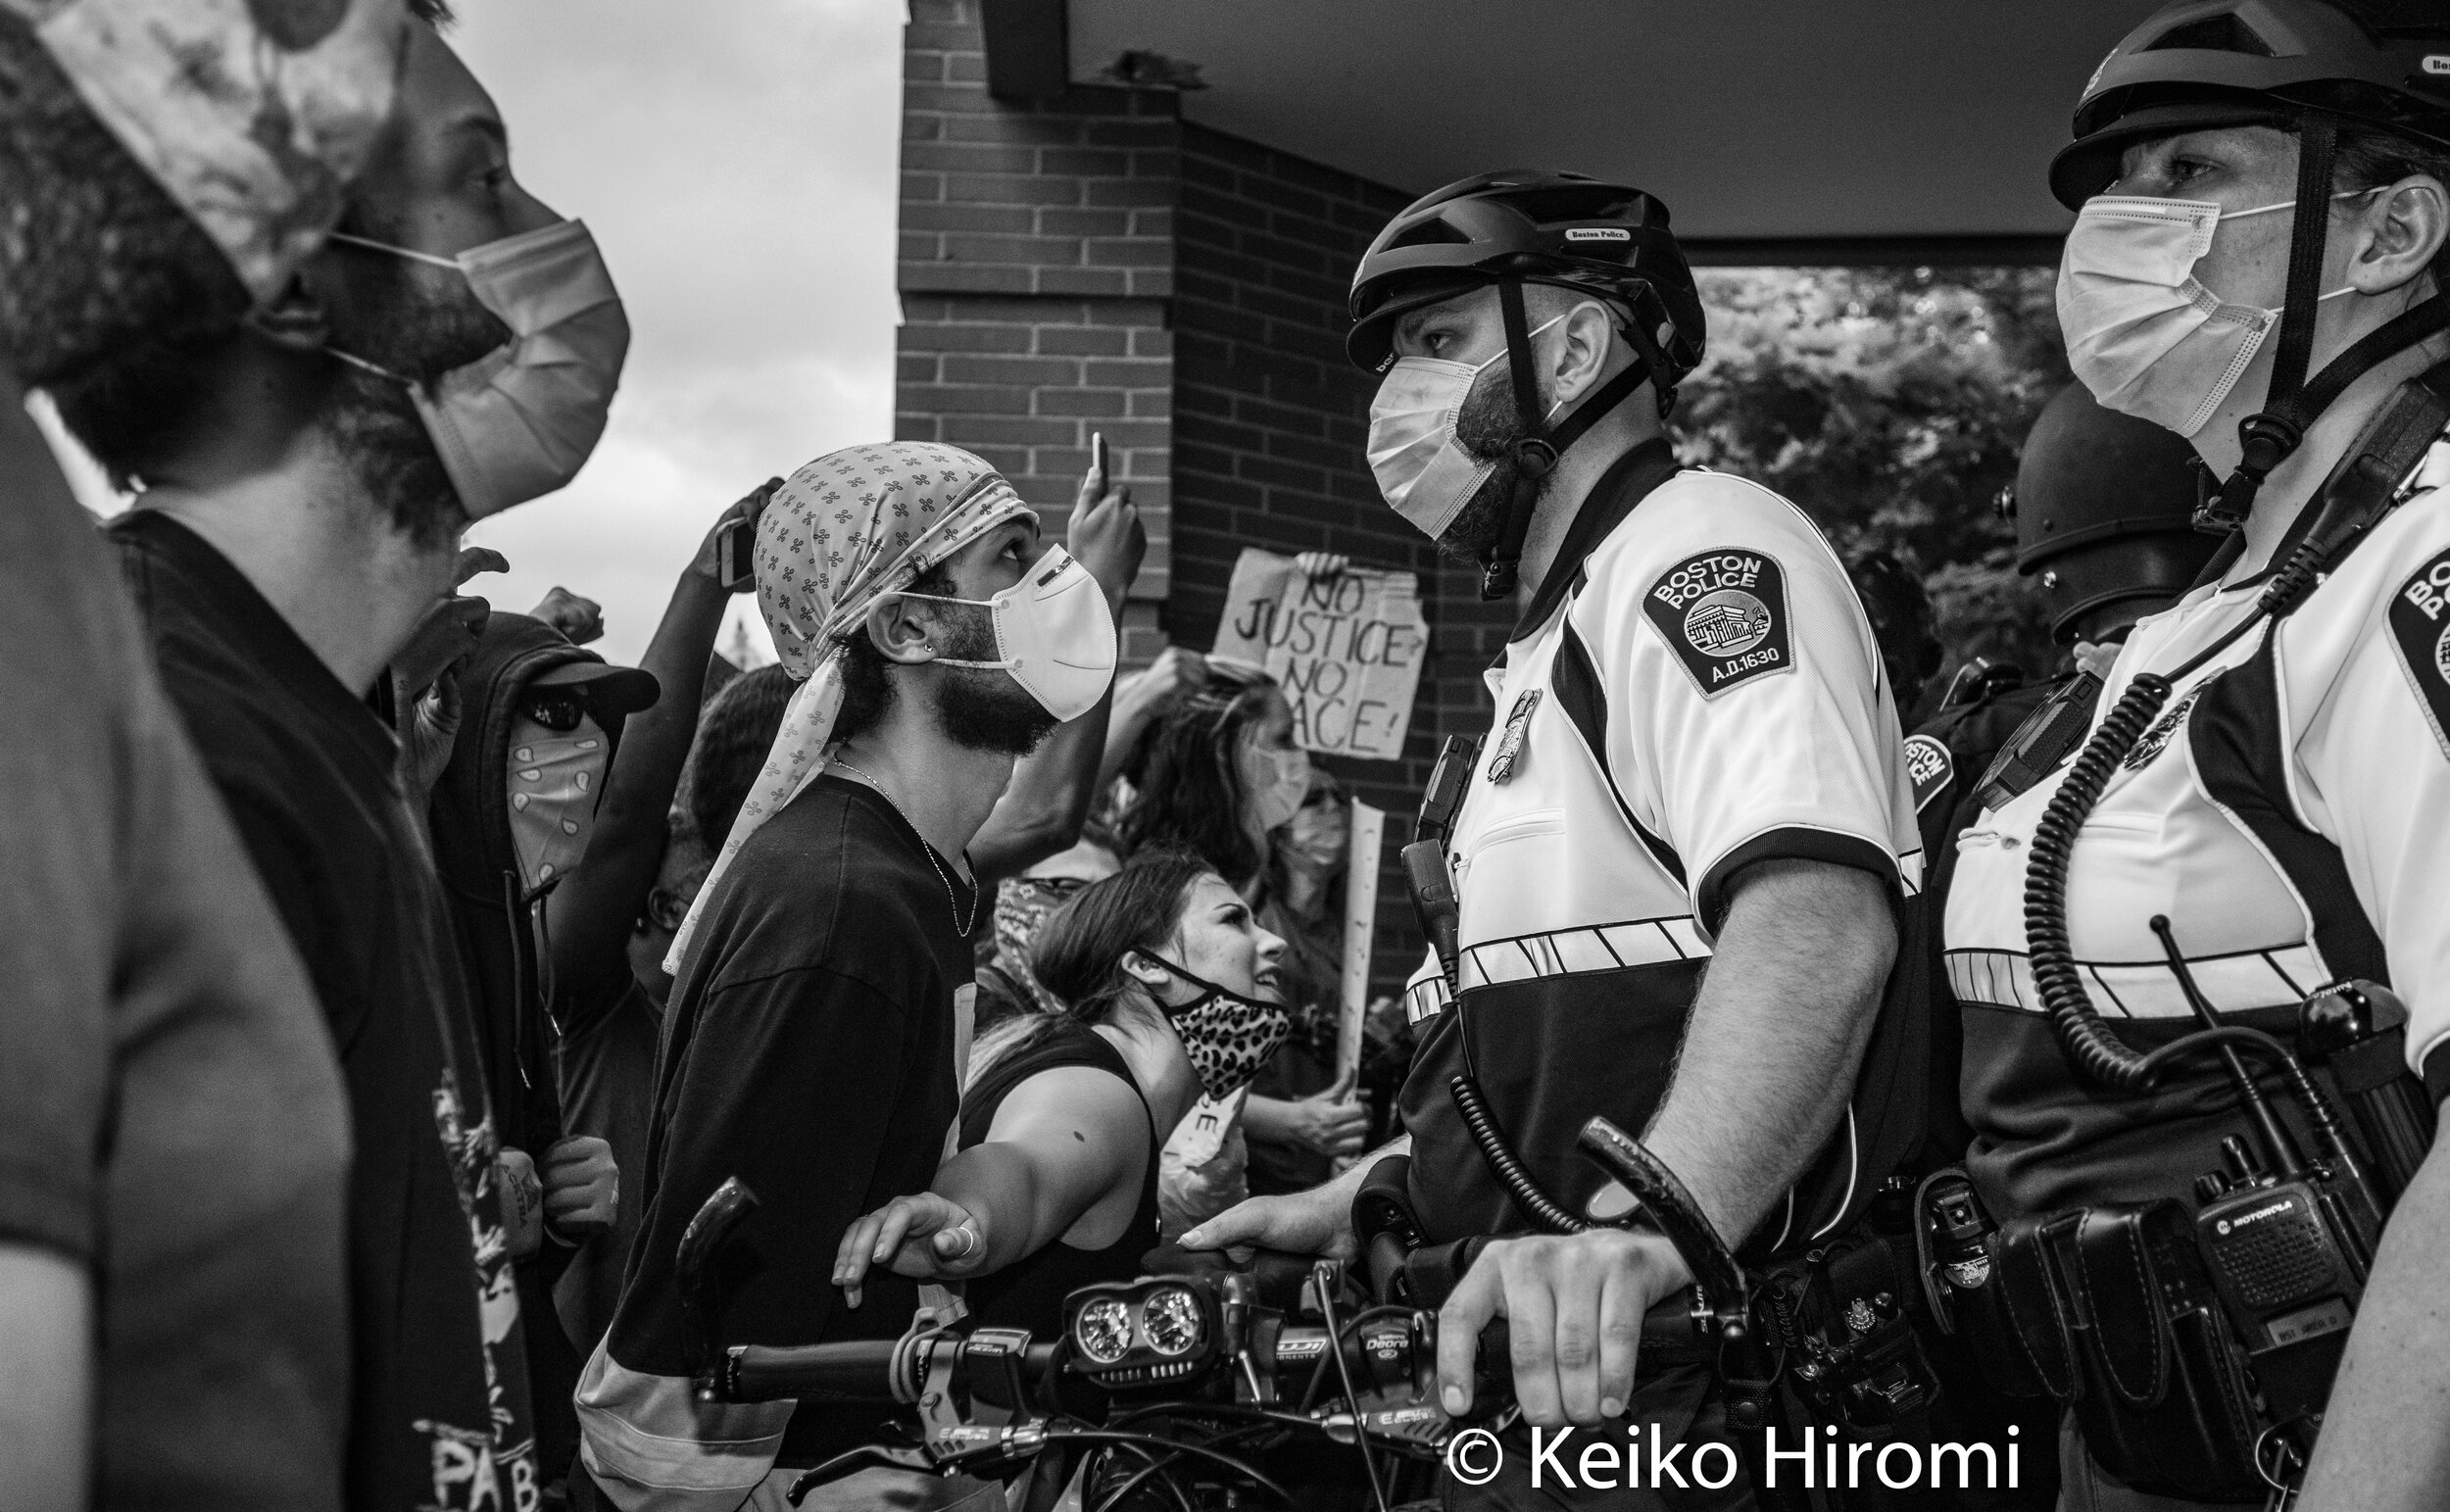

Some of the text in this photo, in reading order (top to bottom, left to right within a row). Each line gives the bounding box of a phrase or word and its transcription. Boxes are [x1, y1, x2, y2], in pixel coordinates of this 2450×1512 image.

[1600, 230, 1625, 239] Police
[1300, 570, 1365, 615] NO
[1653, 556, 1762, 603] BOSTON
[1668, 572, 1758, 610] POLICE
[1284, 658, 1348, 699] NO
[1712, 647, 1780, 683] A.D.1630
[1292, 695, 1398, 753] ACE!
[1907, 756, 1932, 786] ICE
[2233, 1199, 2293, 1228] MOTOROLA
[1366, 1339, 1409, 1350] Deore
